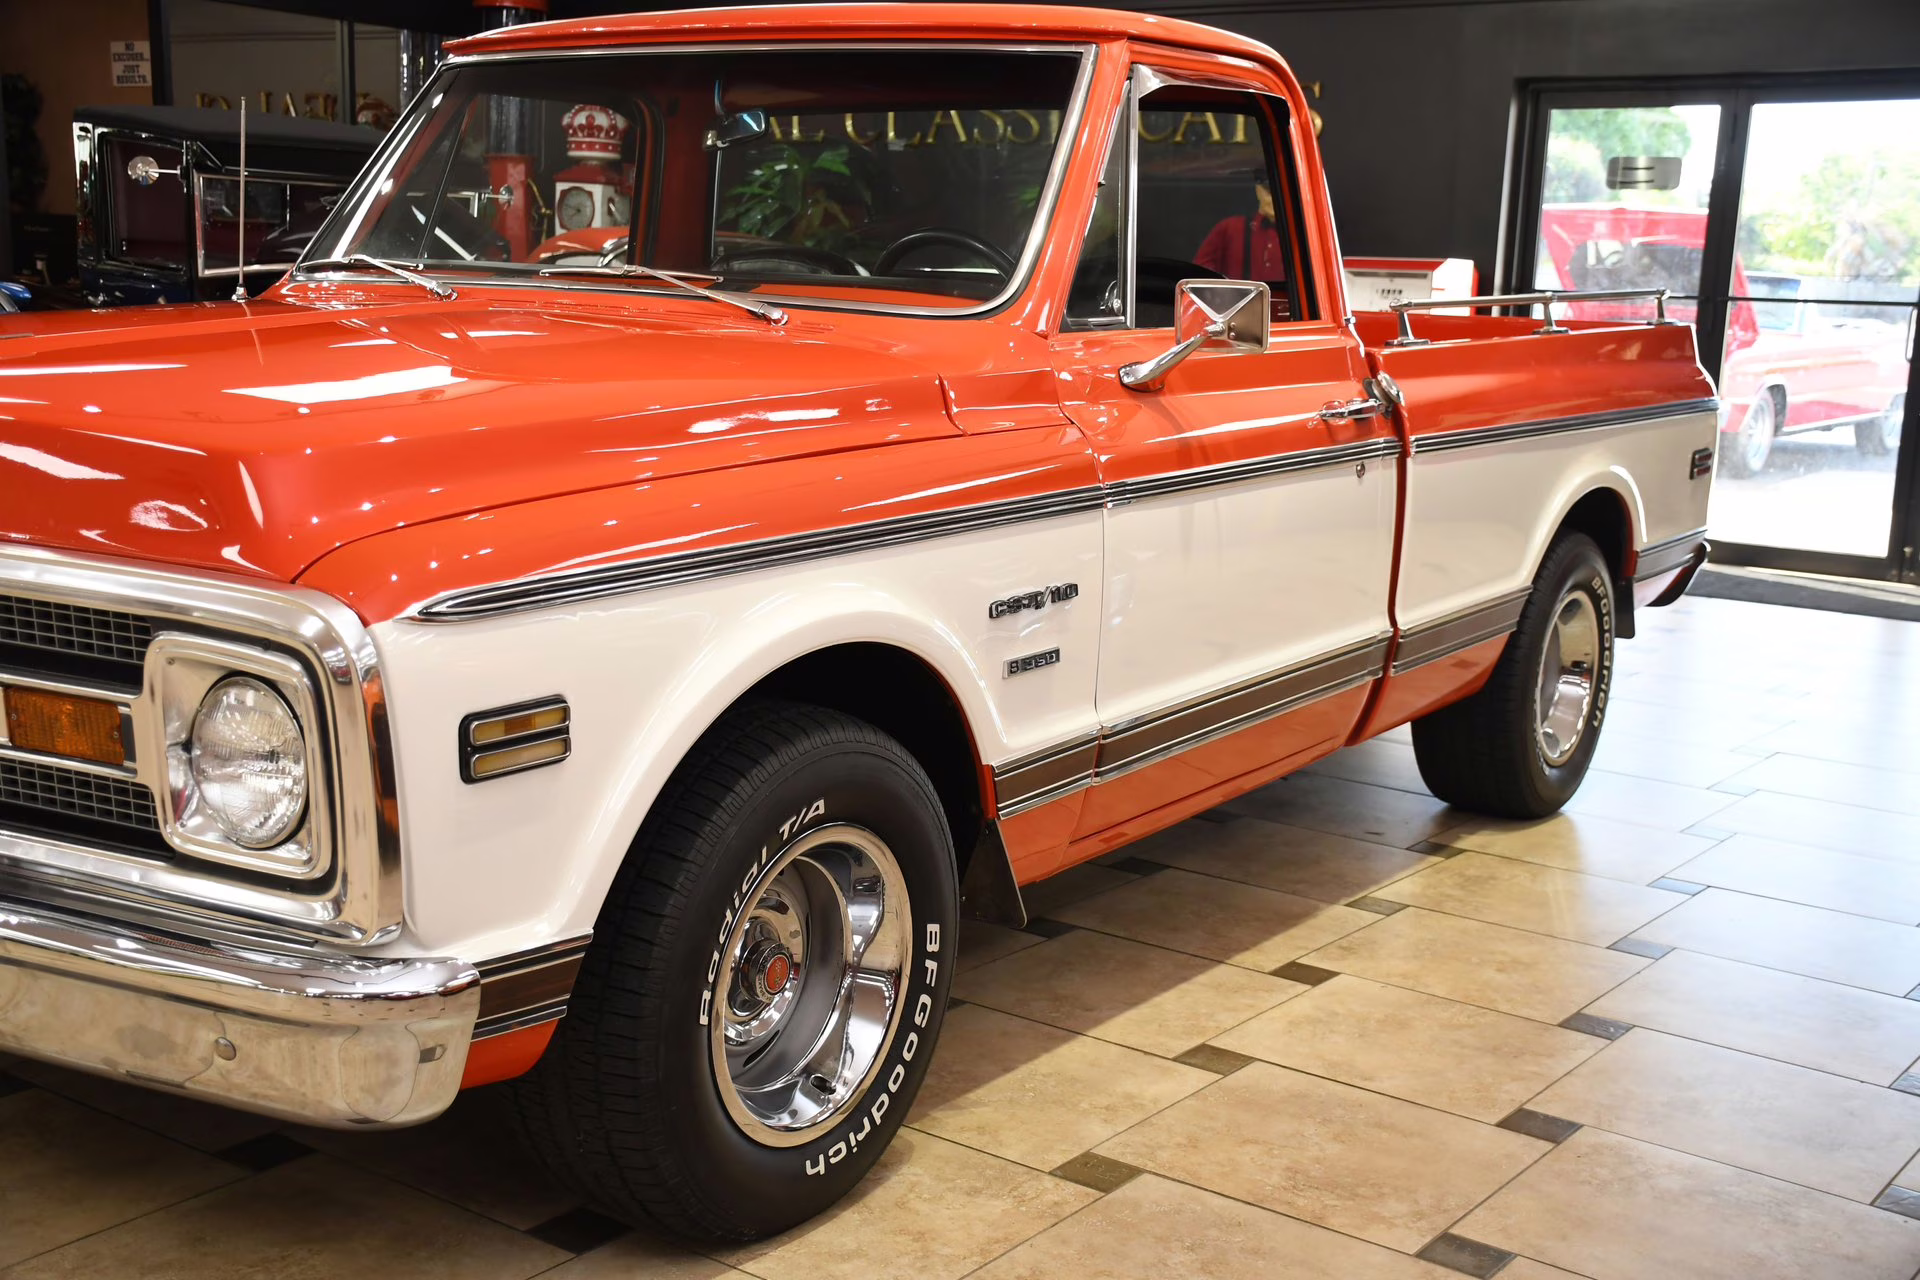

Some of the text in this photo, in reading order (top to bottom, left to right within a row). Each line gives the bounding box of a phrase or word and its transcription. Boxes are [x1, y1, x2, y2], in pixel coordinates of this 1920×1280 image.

[1591, 577, 1612, 729] BFGoodrich
[699, 797, 826, 1026] Radial T/A
[805, 922, 941, 1177] BFGoodrich
